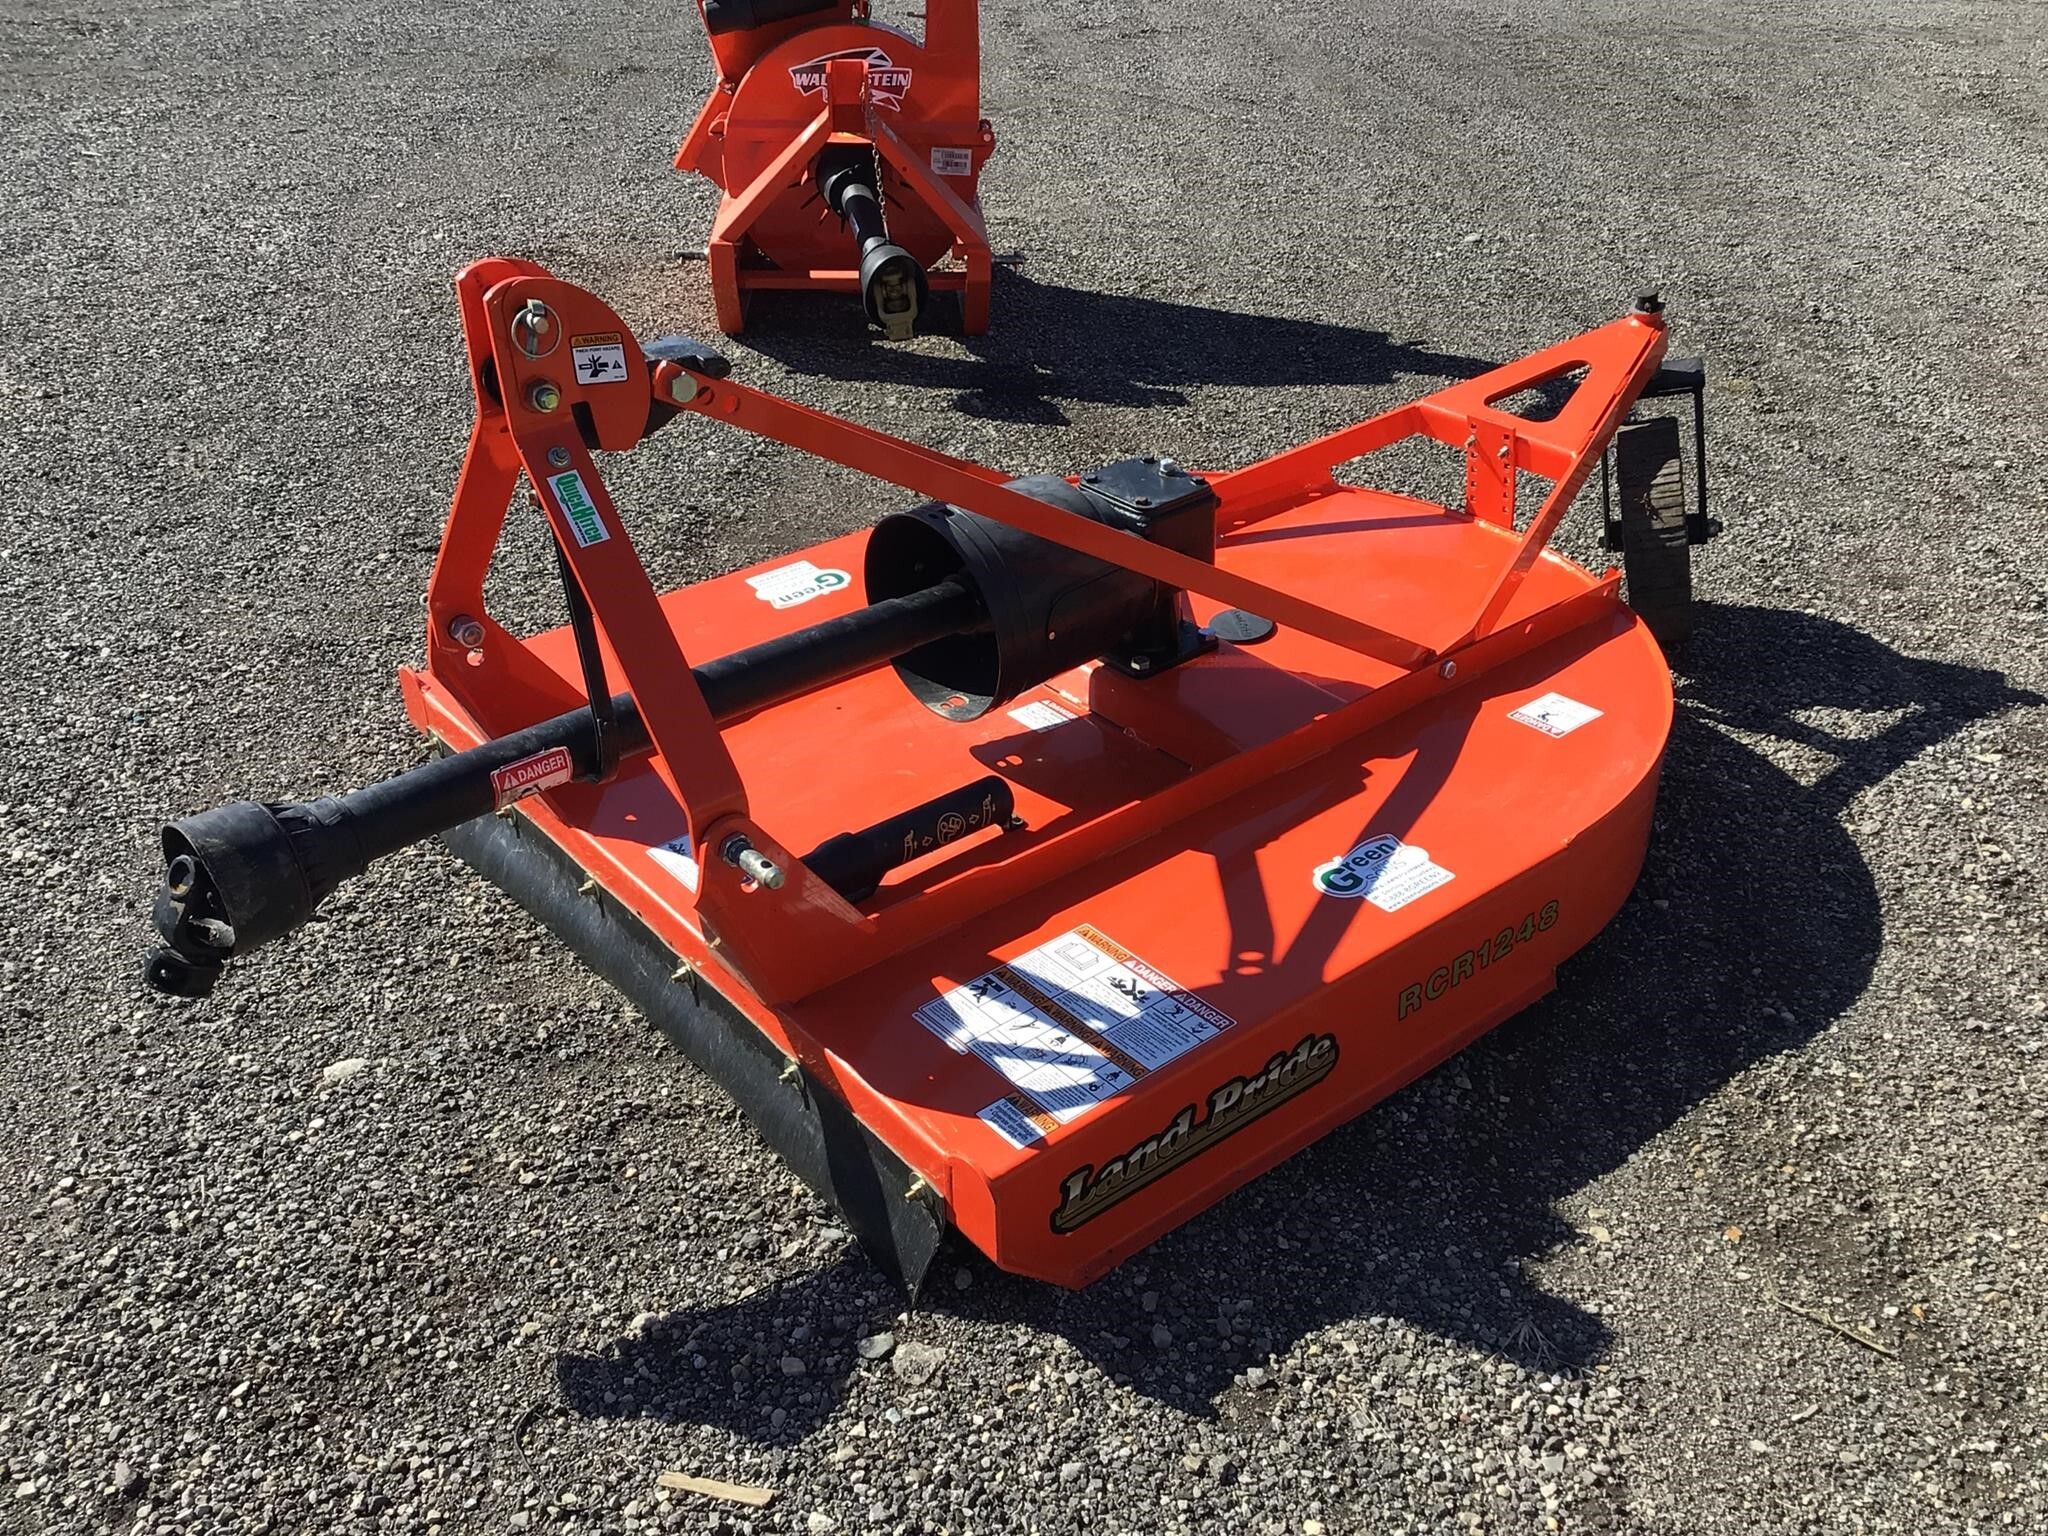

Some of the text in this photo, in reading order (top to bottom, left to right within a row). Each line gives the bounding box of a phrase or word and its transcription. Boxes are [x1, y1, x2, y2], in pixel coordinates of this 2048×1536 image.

[581, 334, 620, 344] WARNING
[778, 573, 845, 602] Green
[518, 755, 566, 783] DANGER
[1320, 842, 1398, 892] Green
[1087, 932, 1231, 1028] WARNING DANGER DANGER
[1398, 899, 1559, 1021] RCR1248
[1006, 974, 1045, 1005] WARNING
[1053, 1008, 1090, 1039] WARNING
[1102, 1044, 1145, 1077] WARNING
[1020, 1096, 1056, 1130] WARNING
[1060, 1103, 1196, 1219] Land
[1207, 1037, 1335, 1132] Pride
